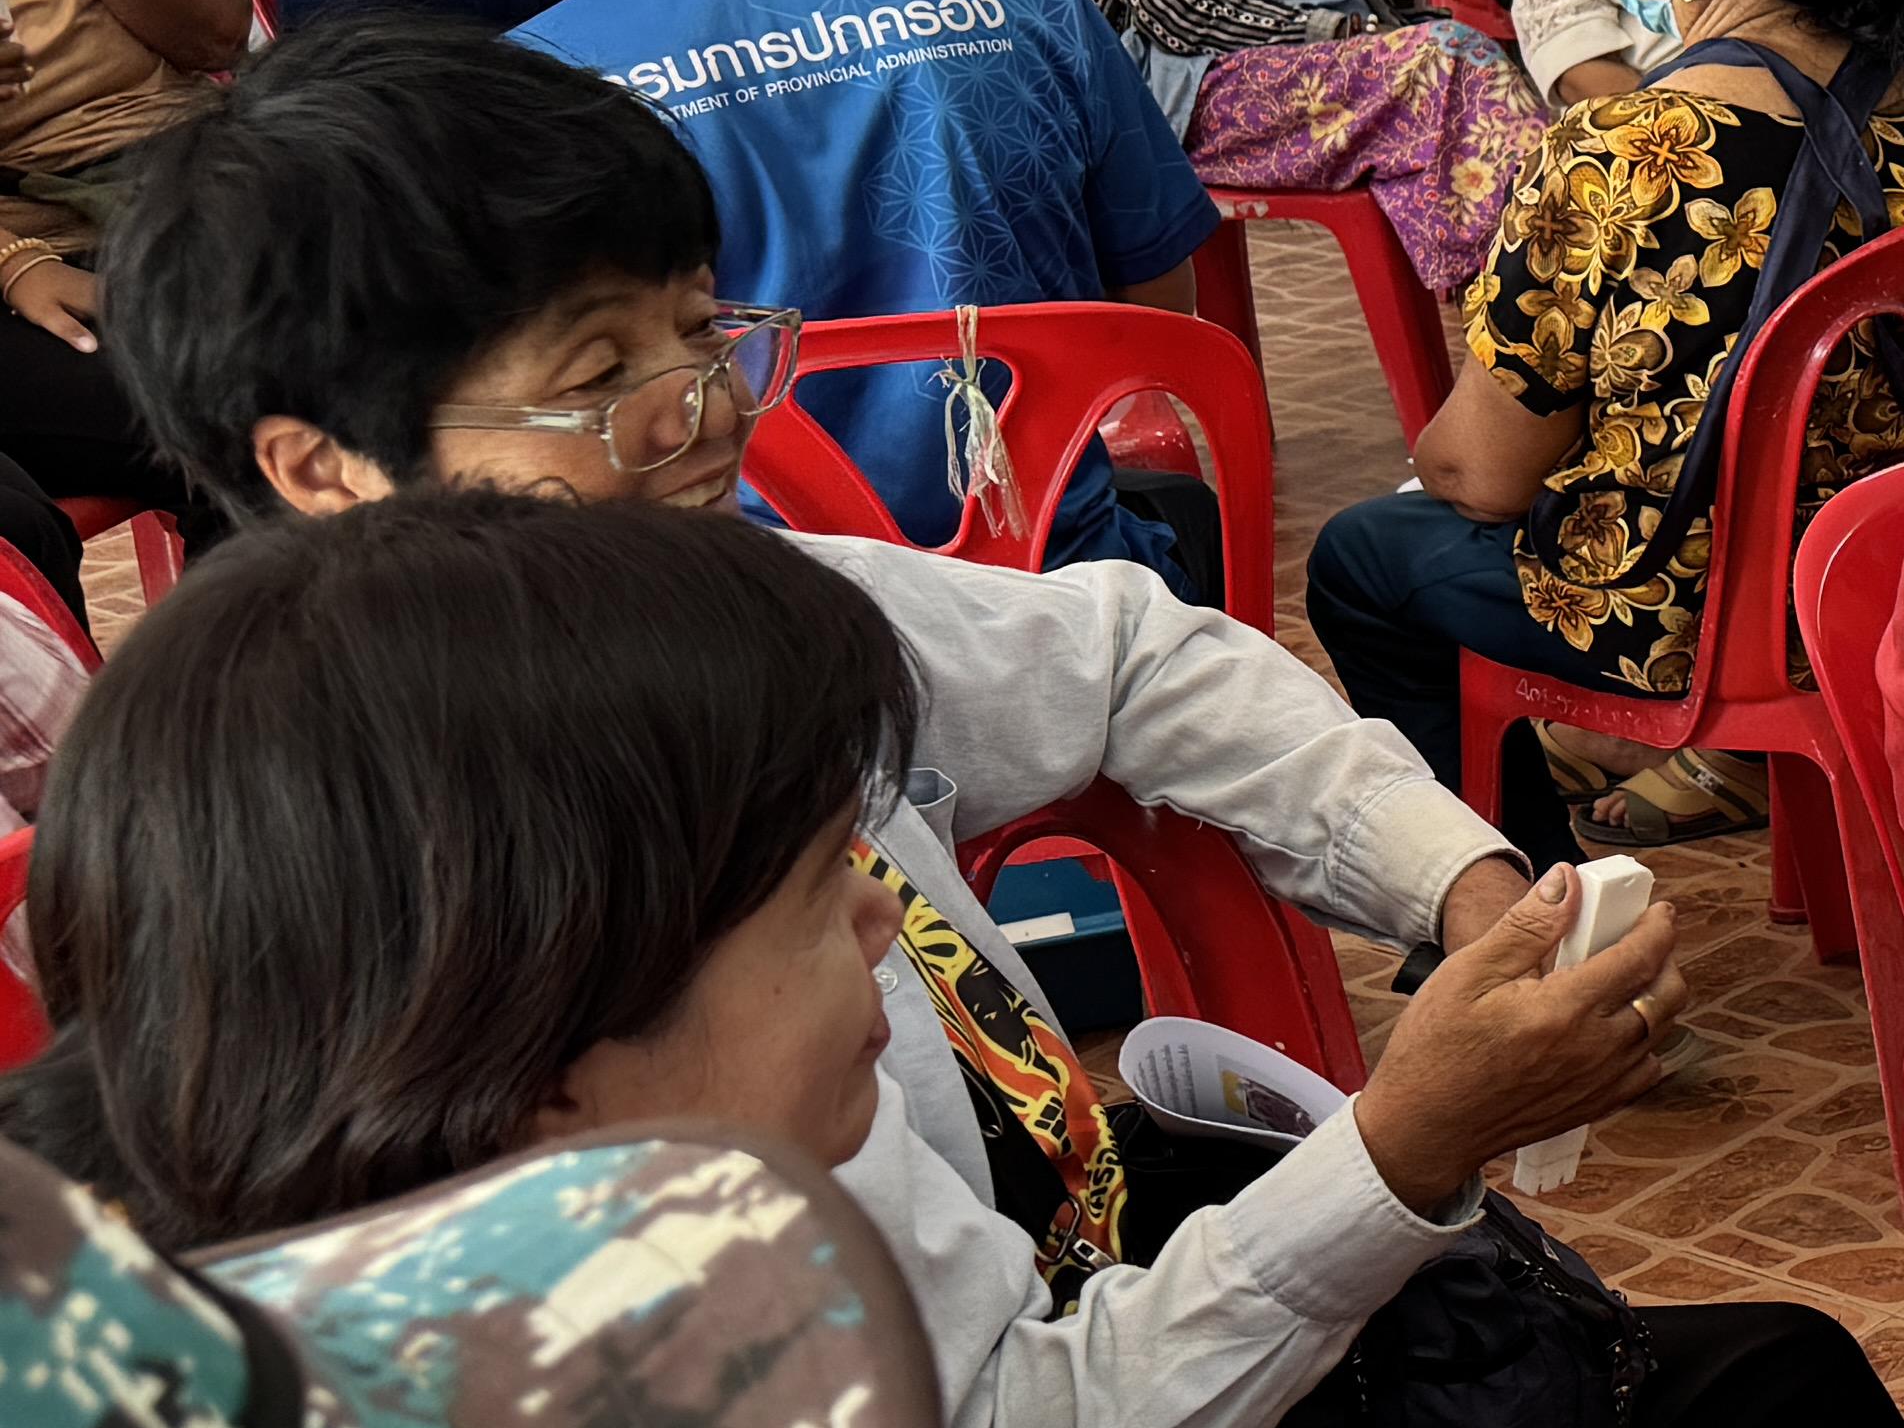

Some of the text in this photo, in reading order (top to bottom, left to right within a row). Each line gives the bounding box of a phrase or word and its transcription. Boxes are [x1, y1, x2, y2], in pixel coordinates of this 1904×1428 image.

[735, 86, 760, 104] OF
[766, 62, 872, 98] PROVINCIAL
[876, 38, 1013, 72] ADMINISTRATION
